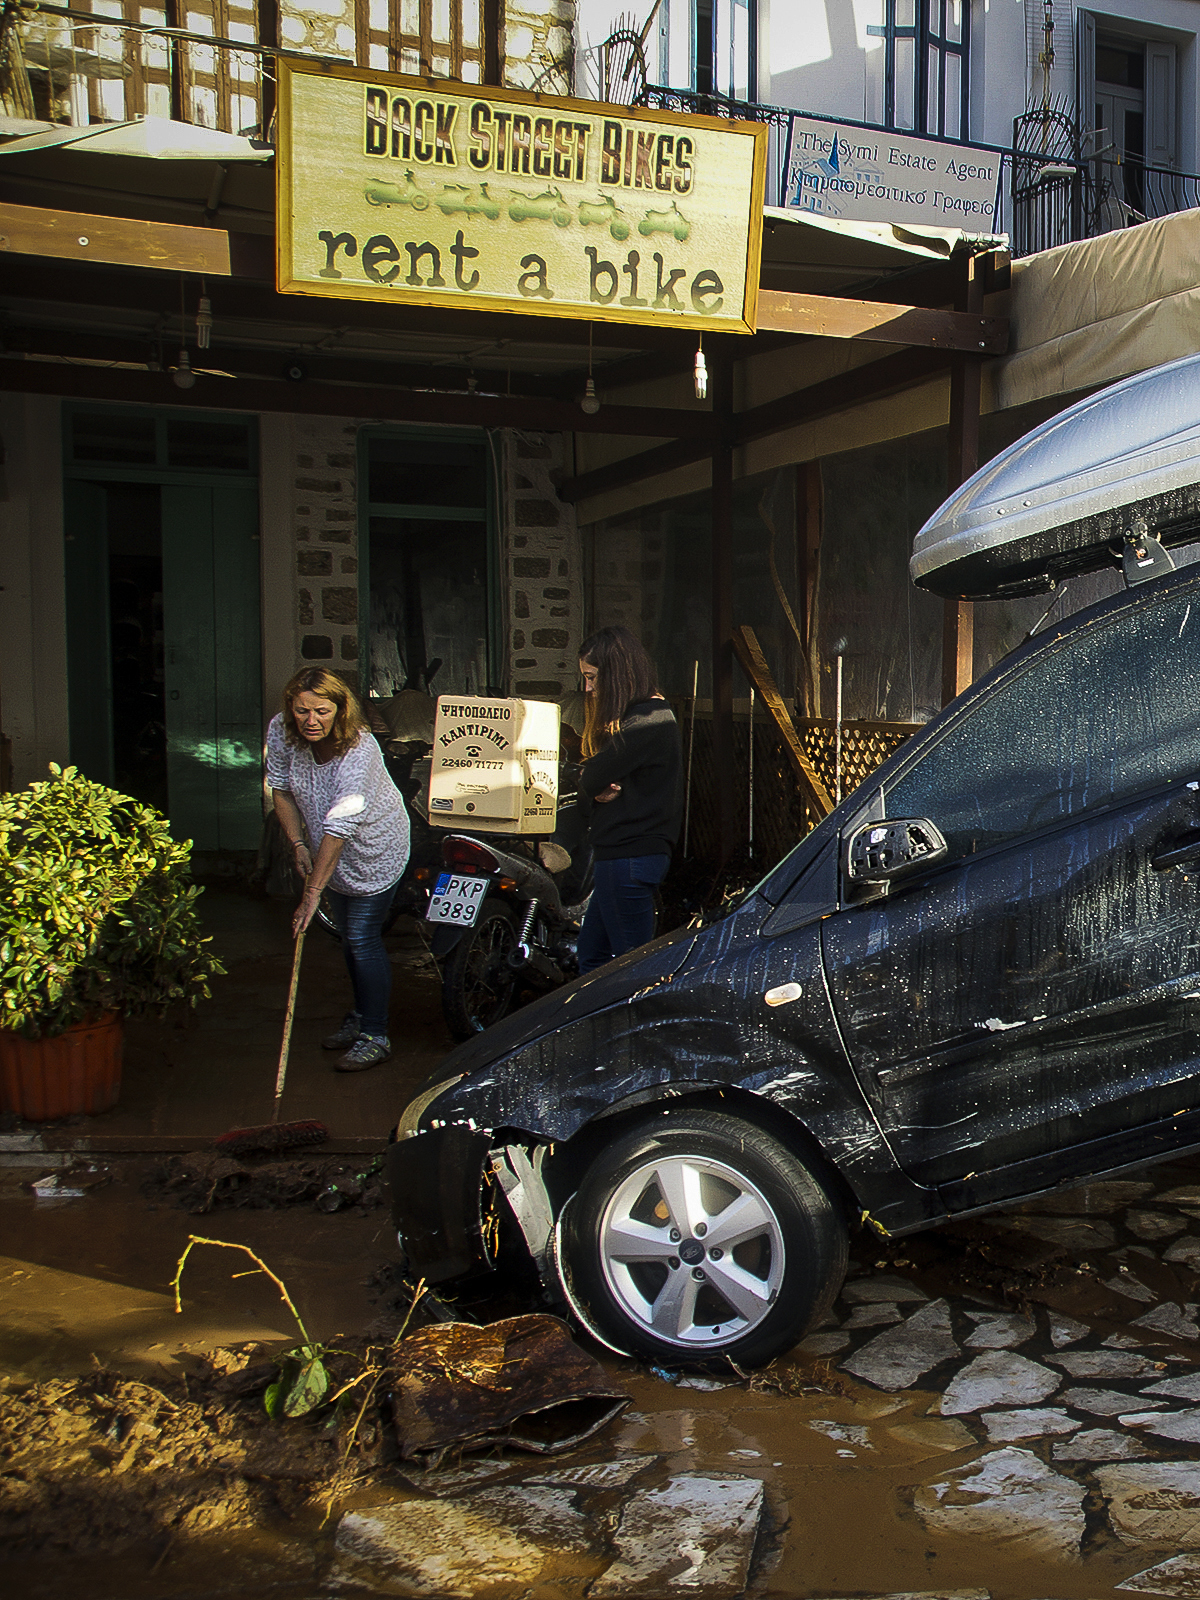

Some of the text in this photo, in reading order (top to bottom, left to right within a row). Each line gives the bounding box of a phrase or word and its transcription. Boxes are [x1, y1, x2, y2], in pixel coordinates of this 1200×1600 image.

[468, 101, 592, 183] STREET
[600, 117, 696, 196] BIKES
[800, 131, 993, 181] The Symi Estate Agent
[933, 191, 994, 216] Γραφείο
[318, 230, 725, 315] rent a bike
[441, 704, 511, 720] ΨΗΤΟΠΩΛΕΙΟ
[439, 724, 510, 751] ΚΑΝΤΙΡΙΜΙ
[441, 757, 504, 770] 22460 71777
[445, 879, 485, 899] PKP
[438, 900, 477, 921] 389
